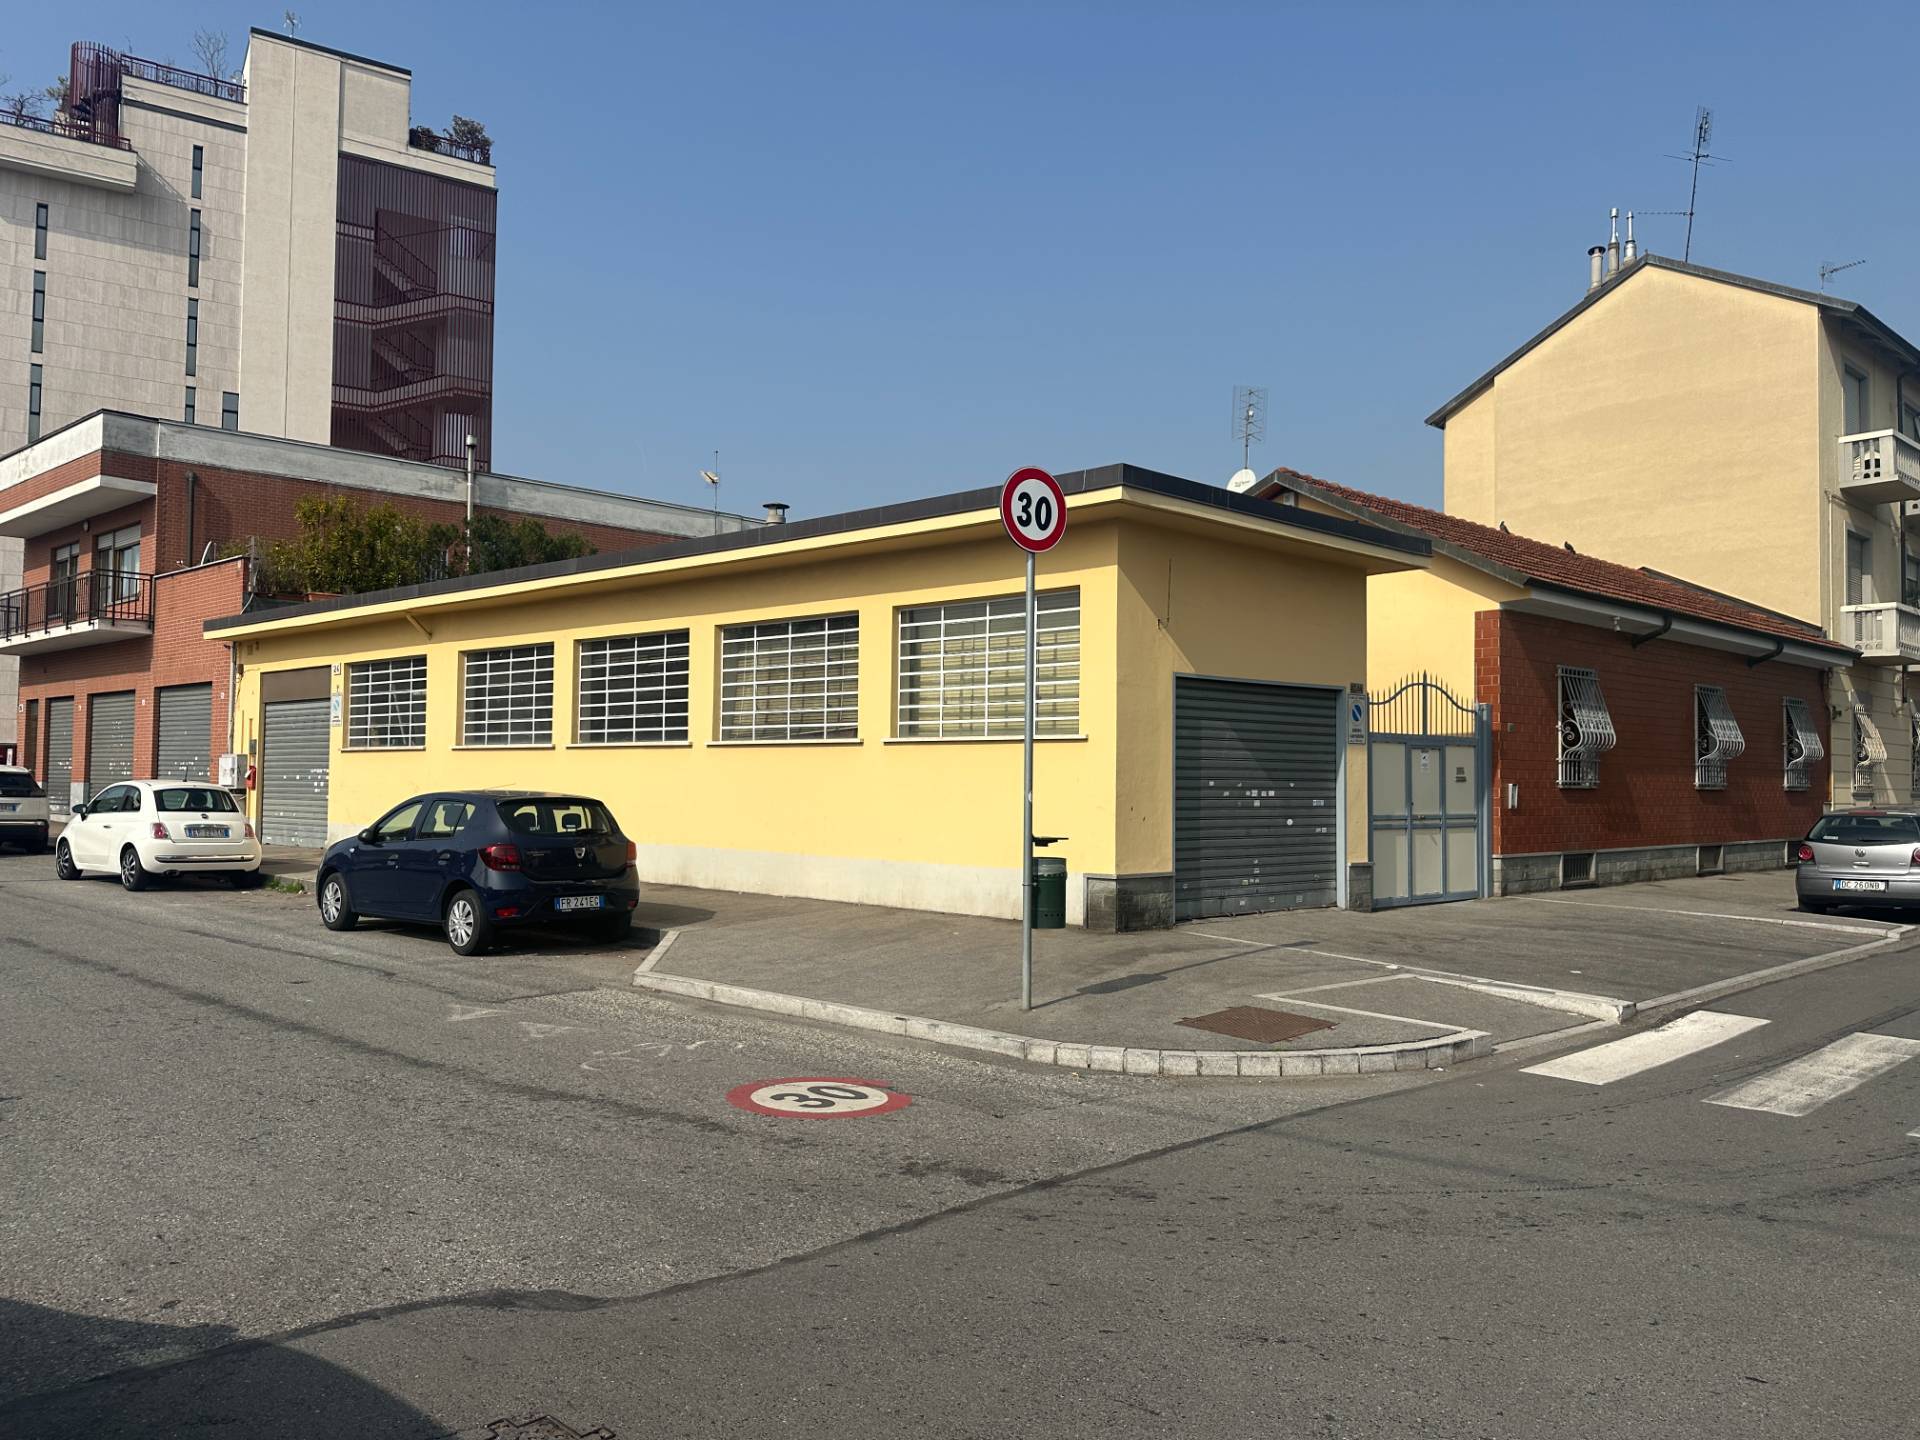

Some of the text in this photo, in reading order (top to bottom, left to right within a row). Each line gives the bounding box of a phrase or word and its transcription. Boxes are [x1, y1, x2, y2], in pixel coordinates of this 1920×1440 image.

[1016, 492, 1052, 531] 30
[561, 898, 572, 908] FR
[768, 1086, 870, 1109] 30
